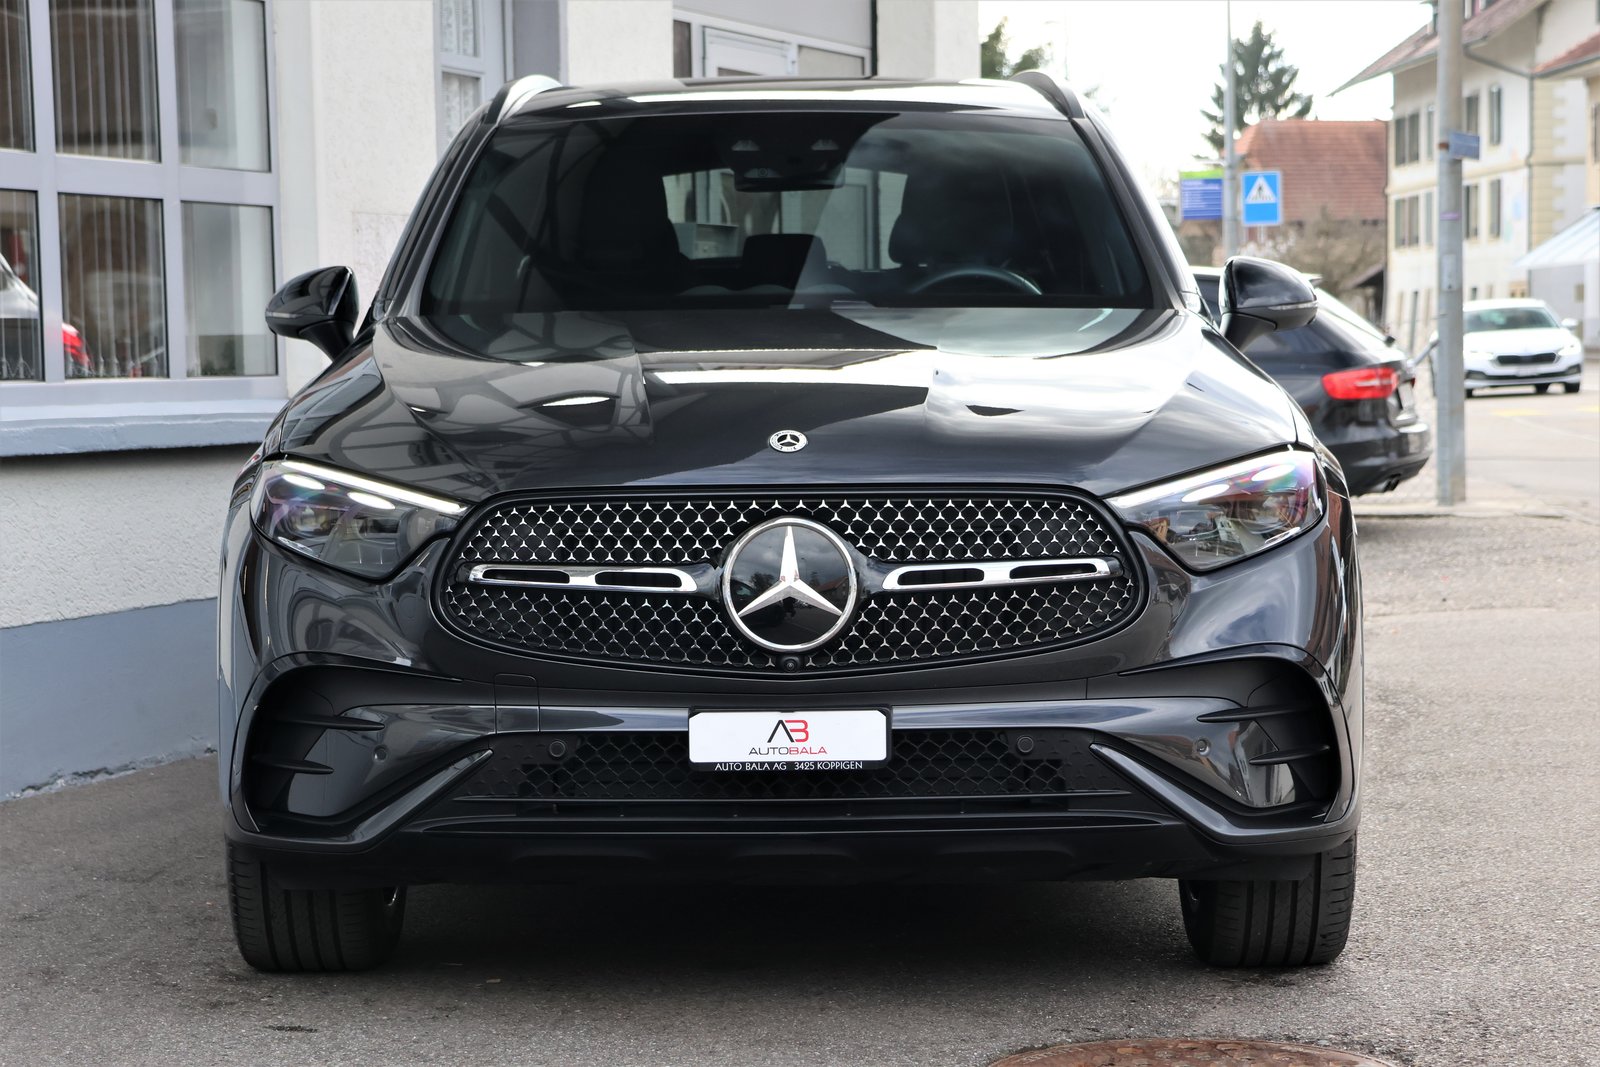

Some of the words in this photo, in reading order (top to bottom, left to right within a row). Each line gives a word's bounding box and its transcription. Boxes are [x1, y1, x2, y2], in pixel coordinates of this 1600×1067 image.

[766, 719, 809, 743] AB
[748, 746, 828, 756] AUTOBALA
[714, 762, 743, 771] AUTO
[745, 762, 770, 771] BALA
[772, 761, 787, 771] AG
[817, 761, 863, 770] KOPPIGEN
